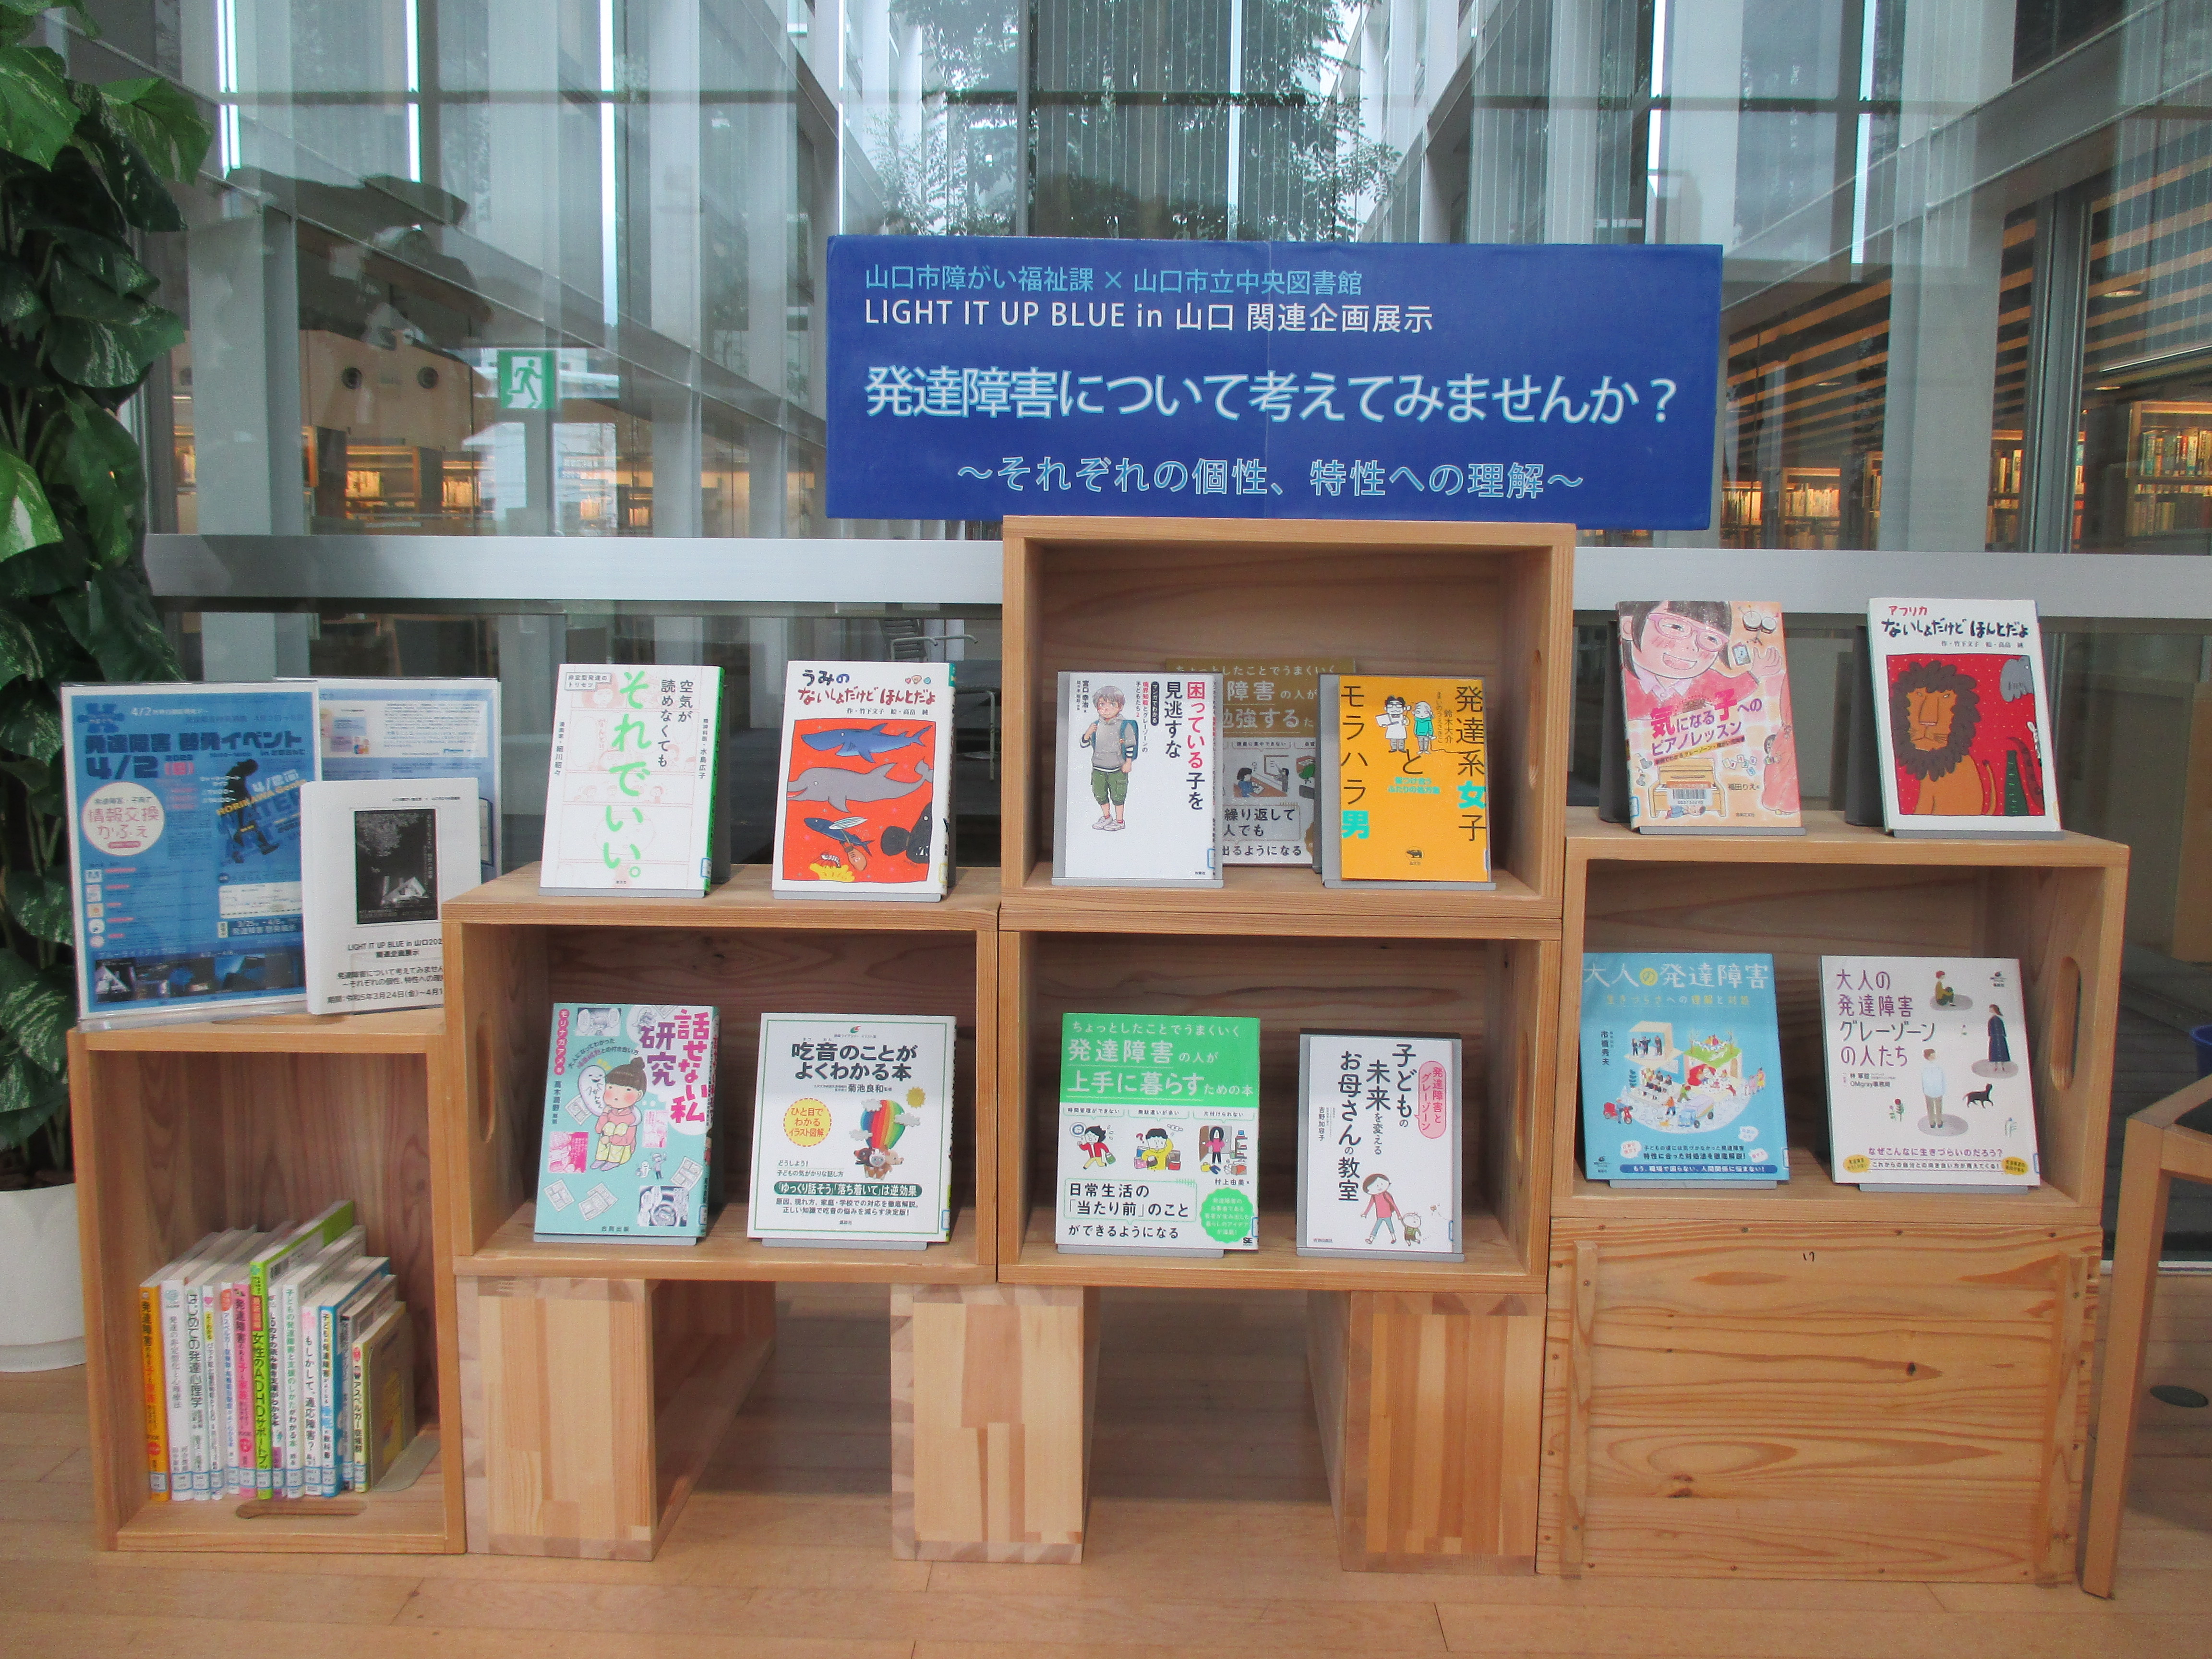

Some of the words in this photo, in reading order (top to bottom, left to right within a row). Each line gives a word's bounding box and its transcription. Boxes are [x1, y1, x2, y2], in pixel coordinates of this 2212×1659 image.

[866, 264, 1094, 292] 山口市障がい福祉課
[1134, 268, 1362, 295] 山口市立中央図書館
[866, 299, 952, 325] LIGHT
[963, 301, 990, 325] IT
[1002, 301, 1039, 326] UP
[1051, 302, 1125, 327] BLUE
[1137, 304, 1162, 328] in
[1176, 303, 1234, 331] 山口
[1247, 303, 1433, 333] 関連企画展示
[865, 365, 1677, 424] 発達障害について考えてみませんか？
[1888, 605, 1928, 616] アフリカ
[1881, 618, 1967, 637] ないしょだけど
[1970, 620, 2029, 637] ほんとだよ
[802, 669, 850, 686] うみの
[677, 680, 694, 723] 空気が
[797, 685, 879, 706] ないしょだけど
[879, 688, 936, 705] ほんとだよ
[658, 679, 676, 768] 読めなくても
[1164, 681, 1183, 758] 見逃すな
[1443, 709, 1454, 744] 鈴木大介
[1650, 689, 1762, 739] 気になる子への
[1186, 681, 1205, 810] 困っている子を
[1652, 721, 1742, 756] ピアノレッスン
[602, 670, 652, 878] それでいい。
[1341, 685, 1370, 839] モラハラ男
[1454, 685, 1487, 842] 発達系女子
[88, 806, 159, 823] 情報交換
[1223, 823, 1264, 837] 人でも
[348, 943, 368, 951] LIGHT
[1583, 962, 1769, 989] 大人の発達障害
[1836, 969, 1890, 991] 大人の
[1837, 994, 1914, 1017] 発達障害
[1072, 1021, 1239, 1037] ちょっとしたことでうまくいく
[1839, 1020, 1935, 1042] グレーゾーン
[639, 1022, 676, 1087] 研究
[791, 1042, 918, 1062] 吃音のことが
[1840, 1045, 1909, 1067] の人たち
[671, 1009, 710, 1124] 話せない私
[794, 1062, 912, 1082] よくわかる本
[1392, 1044, 1417, 1128] 子どもの
[1432, 1067, 1443, 1124] 発達障害と
[791, 1107, 823, 1117] ひと目で
[1365, 1059, 1391, 1155] 未来を変える
[1421, 1072, 1431, 1130] グレーゾーン
[788, 1128, 824, 1138] イラスト図解
[794, 1118, 821, 1127] わかる
[1338, 1050, 1362, 1202] お母さんの教室
[1069, 1182, 1150, 1198] 日常生活の
[1069, 1199, 1190, 1218] 「当たり前」のこと
[1068, 1224, 1179, 1239] ができるようになる
